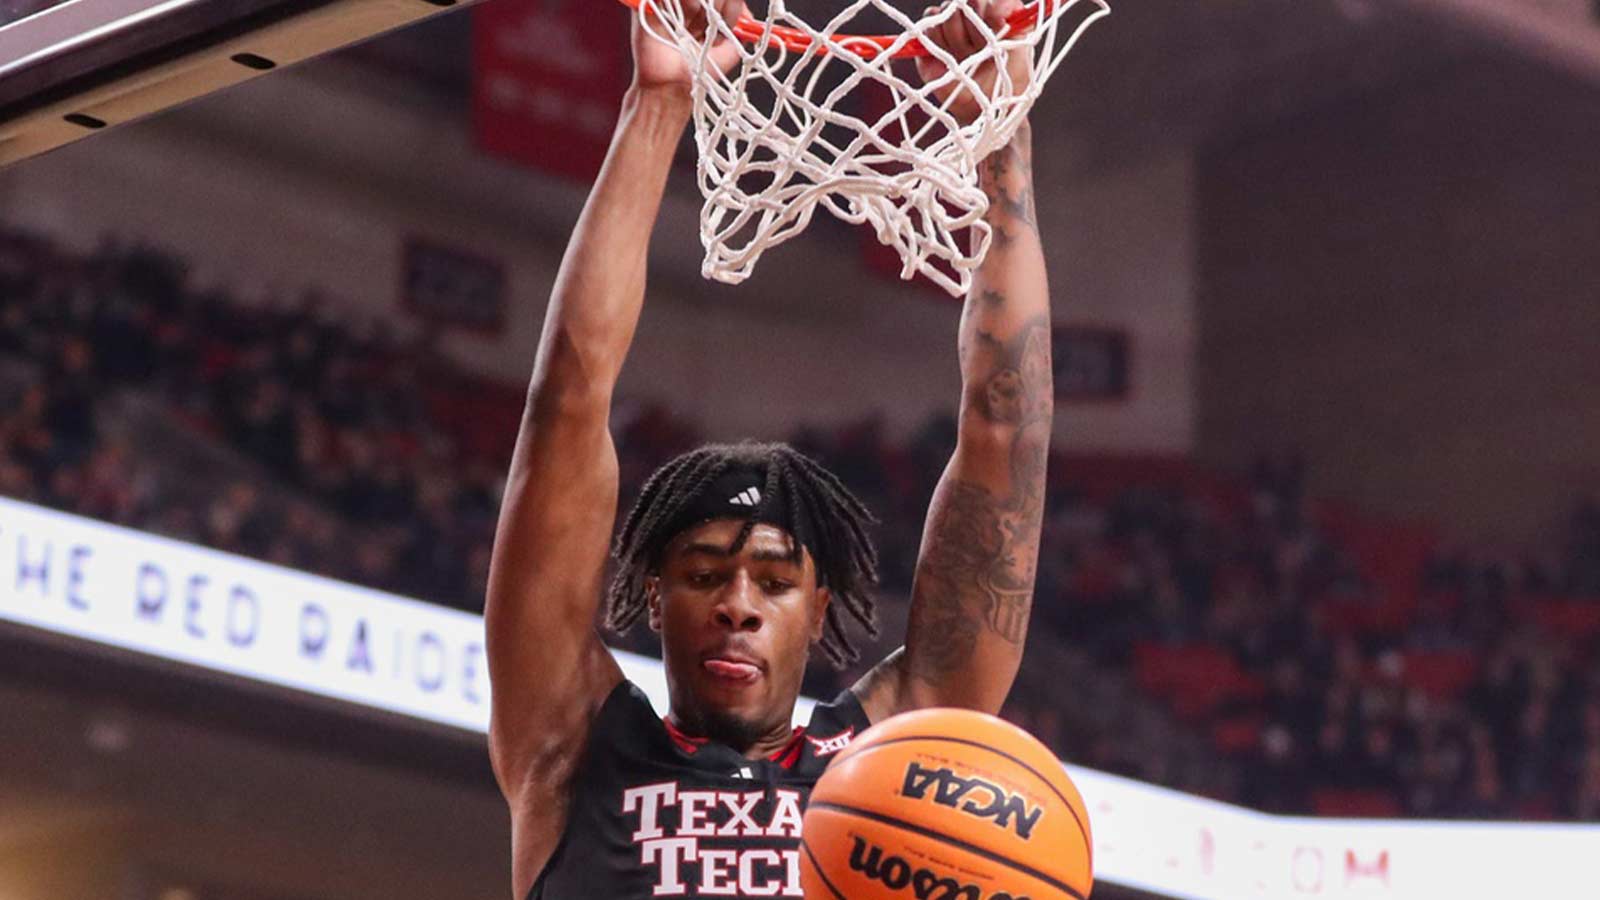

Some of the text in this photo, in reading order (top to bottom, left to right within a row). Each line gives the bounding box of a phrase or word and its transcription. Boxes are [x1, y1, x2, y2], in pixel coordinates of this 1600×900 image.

[0, 527, 483, 704] HE RED RAIDE
[623, 781, 802, 842] TEXA
[901, 760, 1043, 840] NCAA
[848, 835, 1034, 900] lson
